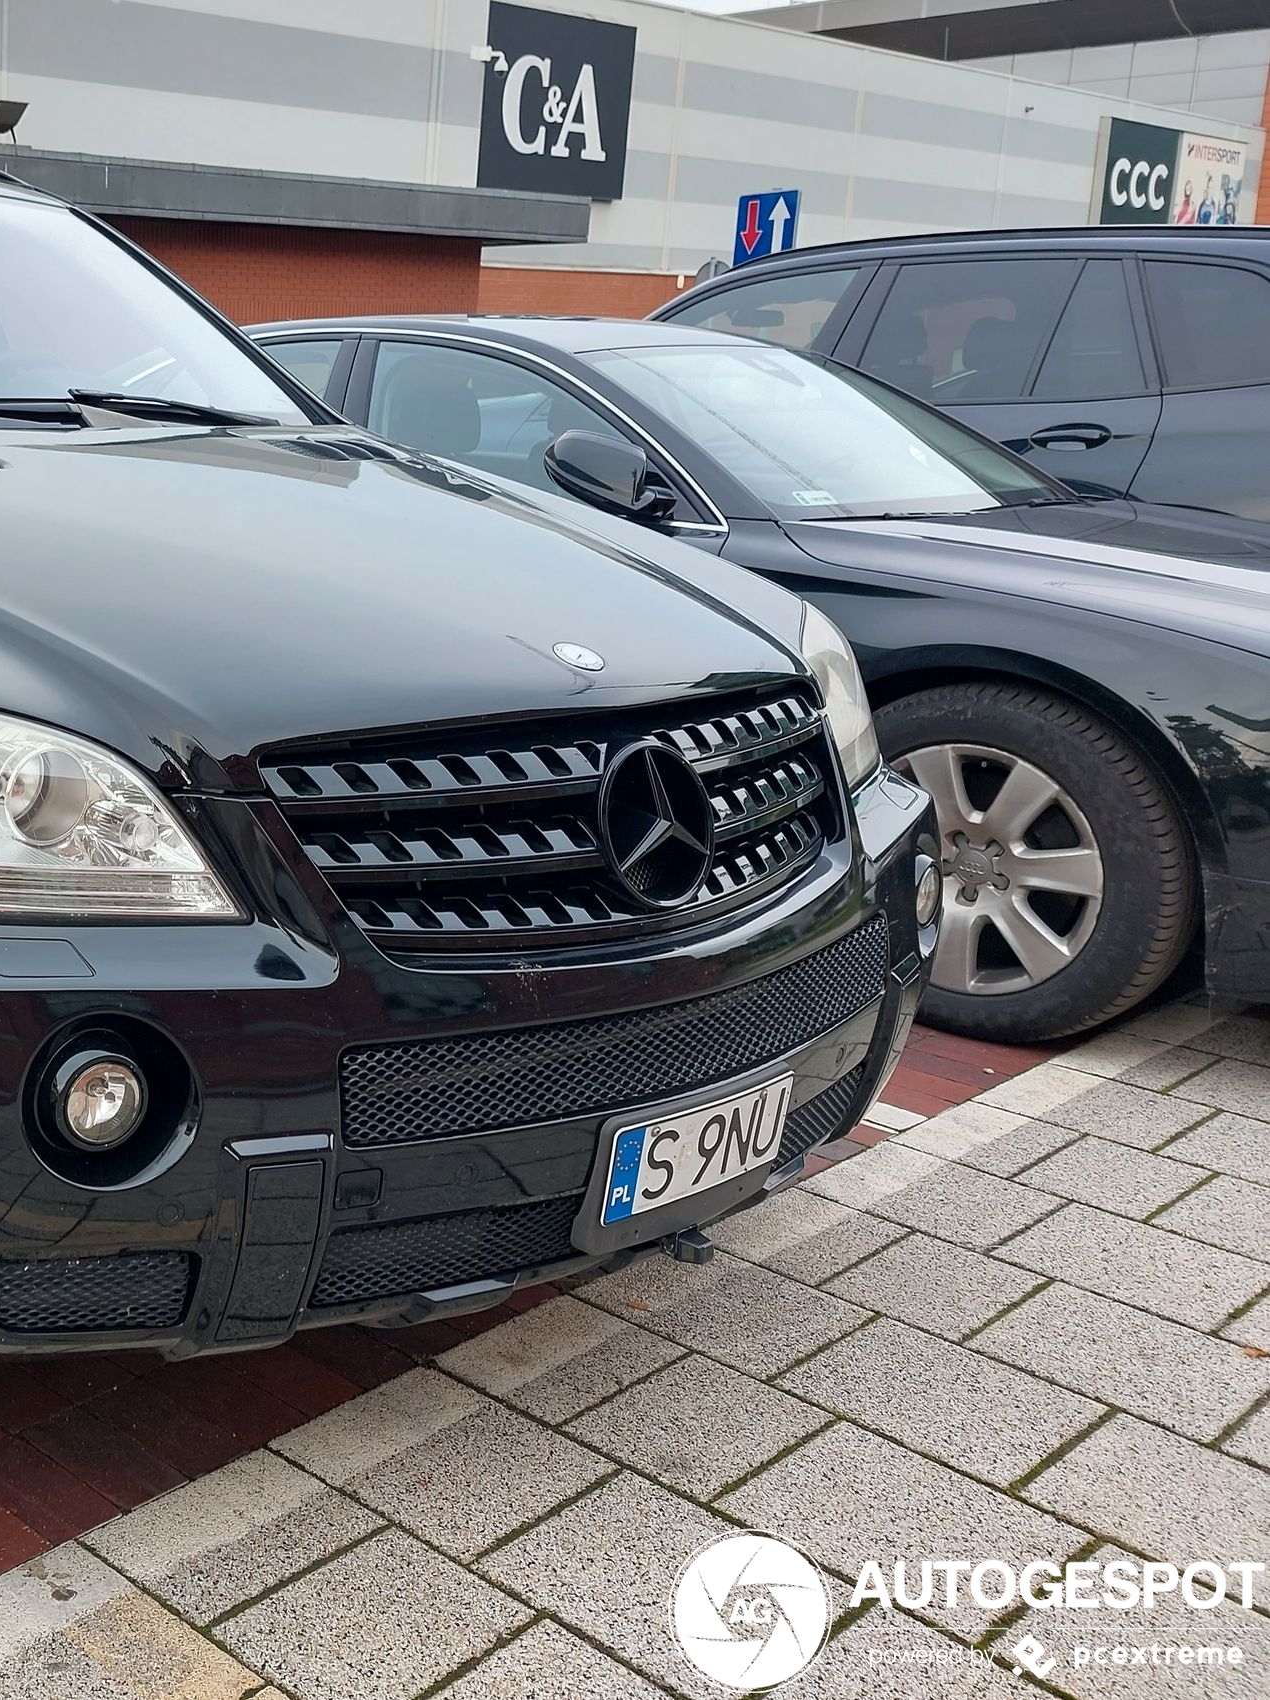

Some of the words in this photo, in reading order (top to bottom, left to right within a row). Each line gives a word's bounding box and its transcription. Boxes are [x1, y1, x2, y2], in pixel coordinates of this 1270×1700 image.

[501, 54, 607, 162] C&A
[1194, 143, 1241, 166] INTERSPORT
[1110, 157, 1168, 211] CCC
[641, 1130, 680, 1200] S
[691, 1086, 786, 1186] 9NU
[611, 1187, 631, 1207] PL
